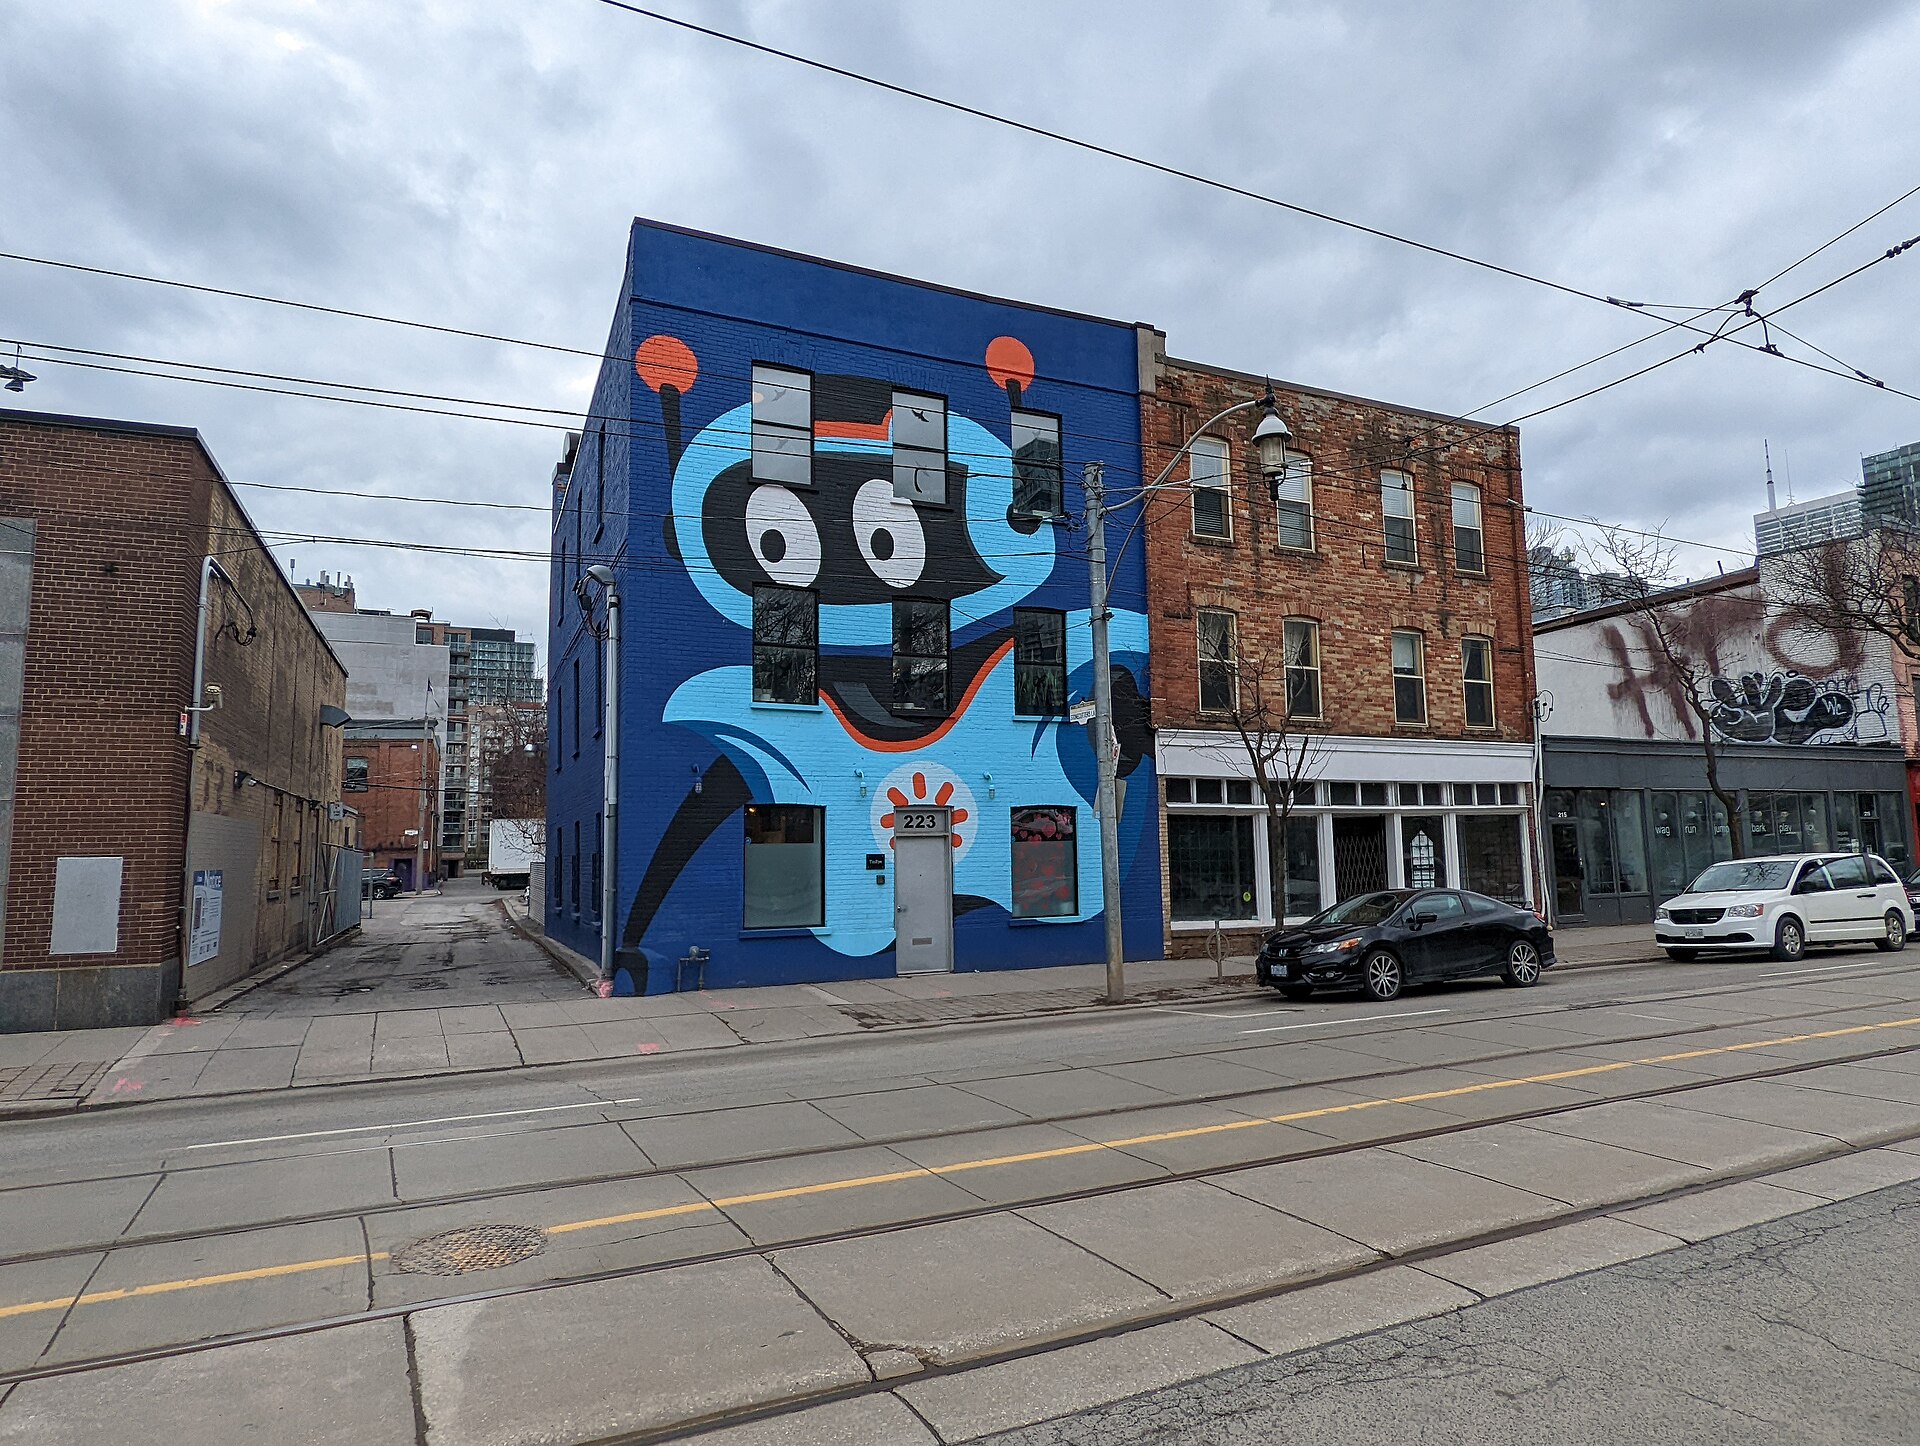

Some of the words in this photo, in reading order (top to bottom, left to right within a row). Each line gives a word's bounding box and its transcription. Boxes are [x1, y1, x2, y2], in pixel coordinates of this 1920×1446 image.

[903, 814, 936, 829] 223
[1655, 825, 1671, 837] wag
[1684, 825, 1697, 834] run
[1751, 823, 1767, 833] bark
